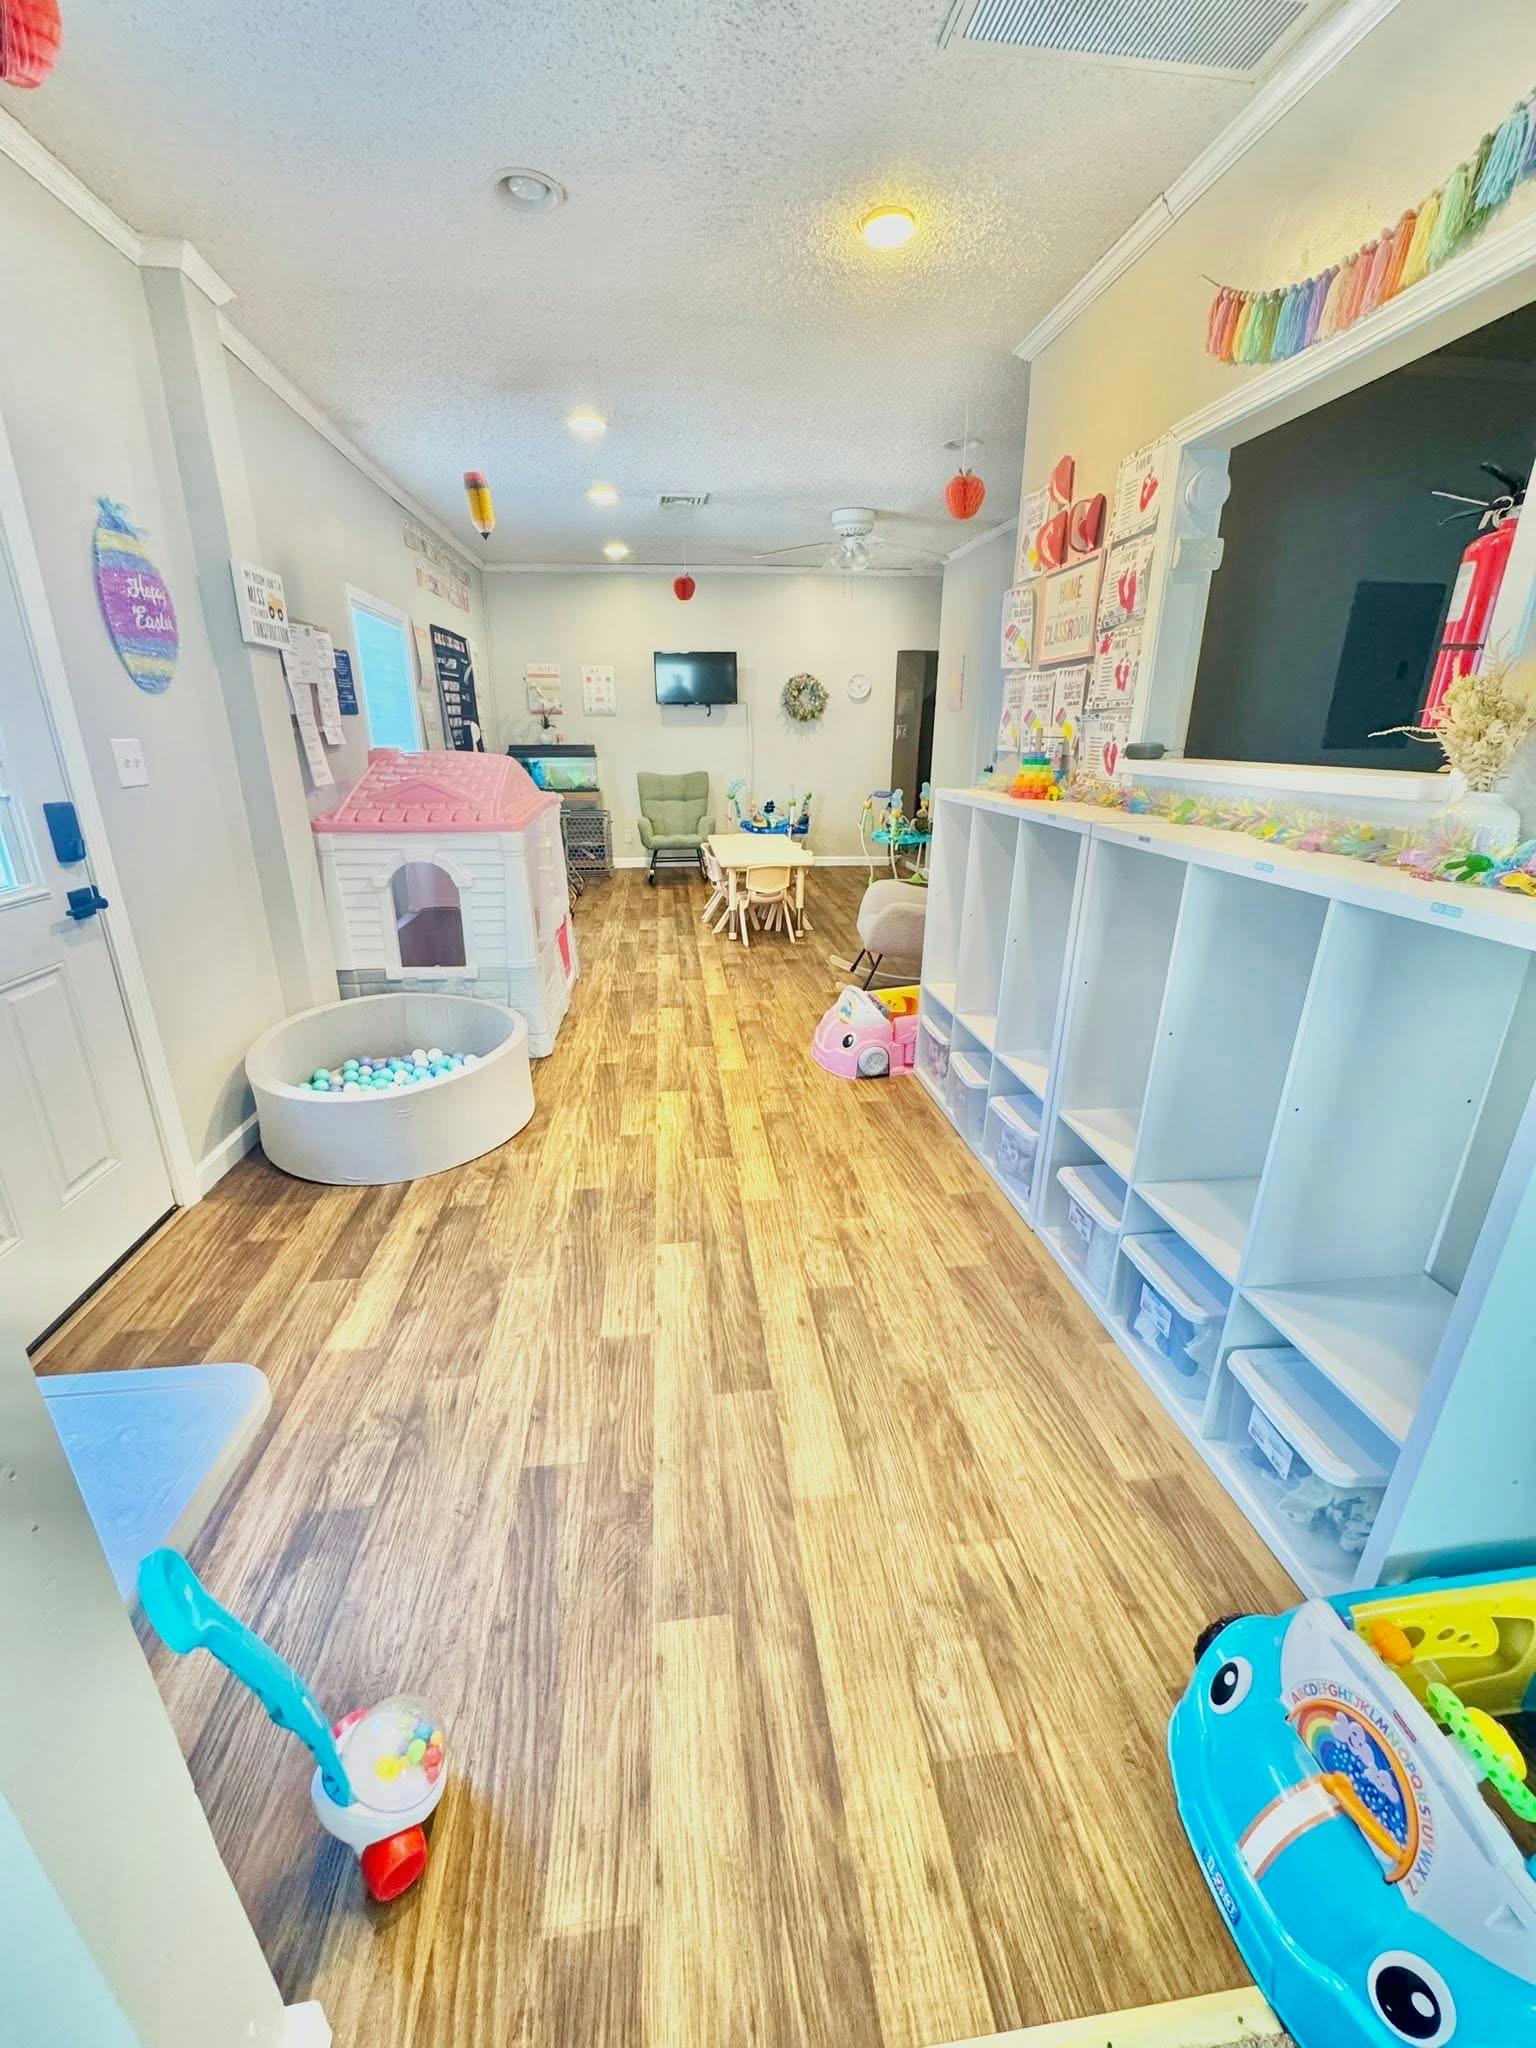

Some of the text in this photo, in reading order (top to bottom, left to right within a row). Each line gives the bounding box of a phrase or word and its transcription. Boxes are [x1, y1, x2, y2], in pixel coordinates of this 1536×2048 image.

[127, 574, 167, 608] Happy
[1059, 574, 1084, 603] HOME
[1044, 613, 1092, 647] CLASSROOM
